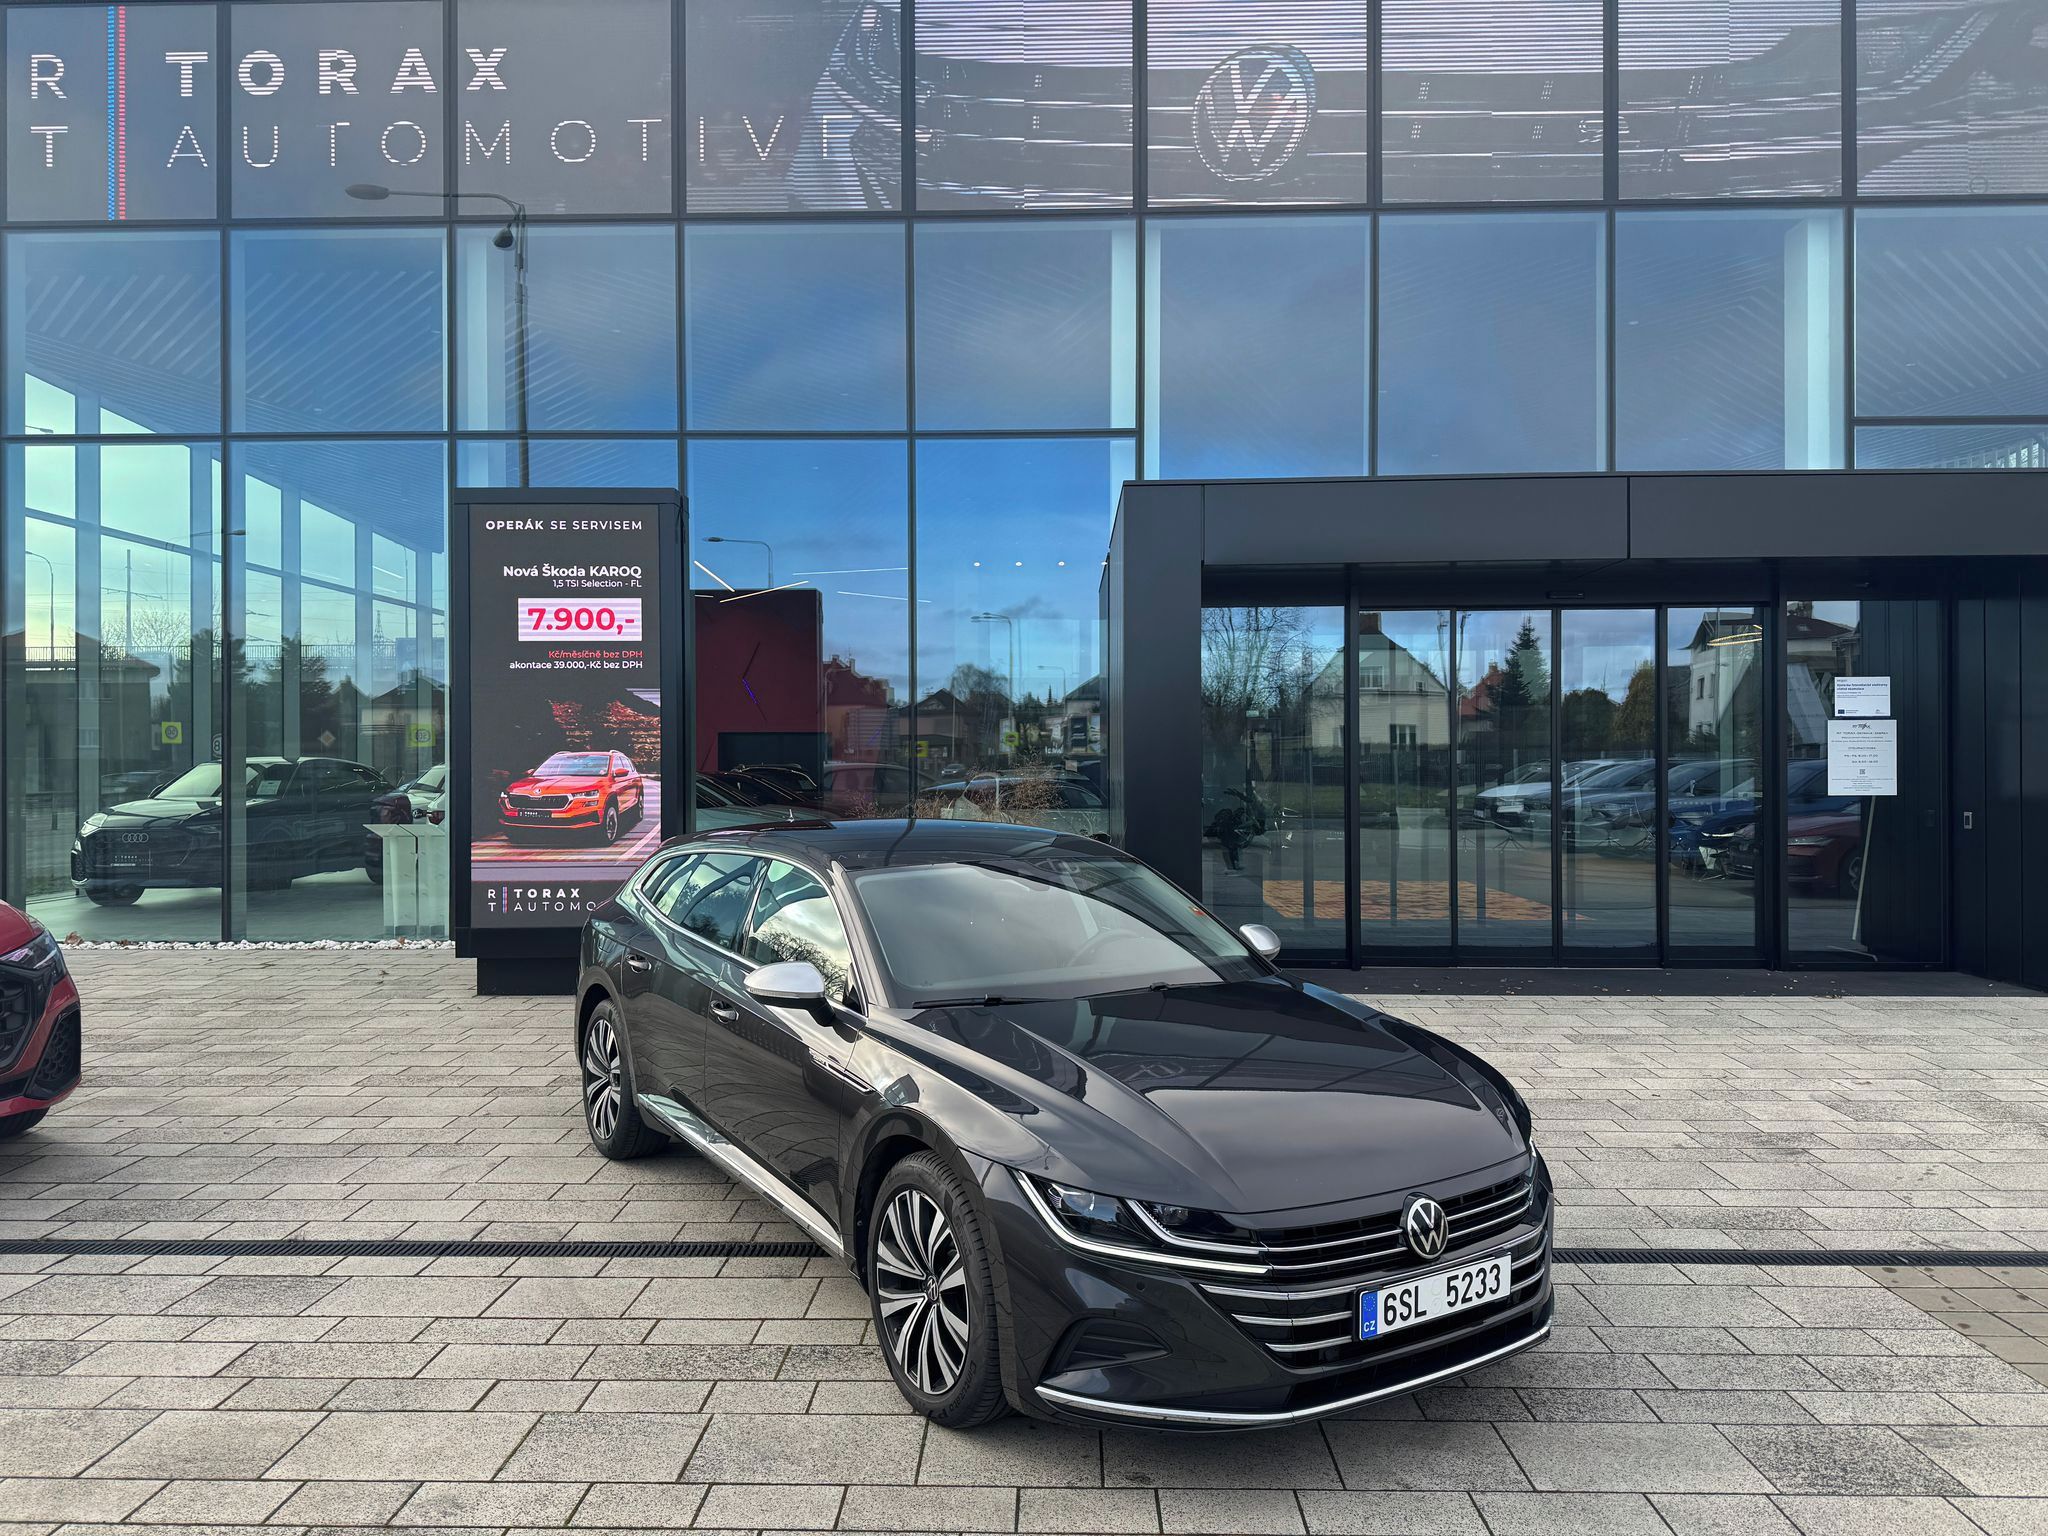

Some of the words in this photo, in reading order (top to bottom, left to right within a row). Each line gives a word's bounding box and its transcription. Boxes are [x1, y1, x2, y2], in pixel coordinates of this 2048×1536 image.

[30, 54, 67, 98] R
[165, 47, 508, 97] TORAX
[30, 126, 68, 167] T
[167, 115, 853, 167] AUTOMOTIVE
[485, 518, 544, 530] OPERÁK
[550, 521, 567, 530] SE
[572, 521, 642, 530] SERVISEM
[503, 564, 538, 577] Nová
[542, 563, 585, 577] Škoda
[590, 566, 642, 578] KAROQ
[553, 579, 564, 589] 1,5
[565, 580, 579, 588] TSI
[581, 579, 623, 588] Selection
[630, 580, 642, 588] FL
[527, 607, 635, 635] 7.900,-
[548, 650, 601, 660] Kč/měsíčně
[603, 651, 620, 659] bez
[622, 651, 643, 659] DPH
[509, 660, 552, 670] akontace
[553, 660, 602, 671] 39.000,-Kč
[603, 660, 620, 670] bez
[622, 661, 643, 670] DPH
[487, 889, 497, 898] R
[513, 888, 580, 899] TORAX
[487, 902, 497, 911] T
[1383, 1285, 1427, 1326] 6SL
[1446, 1263, 1501, 1308] 5233
[1363, 1320, 1376, 1332] CZ
